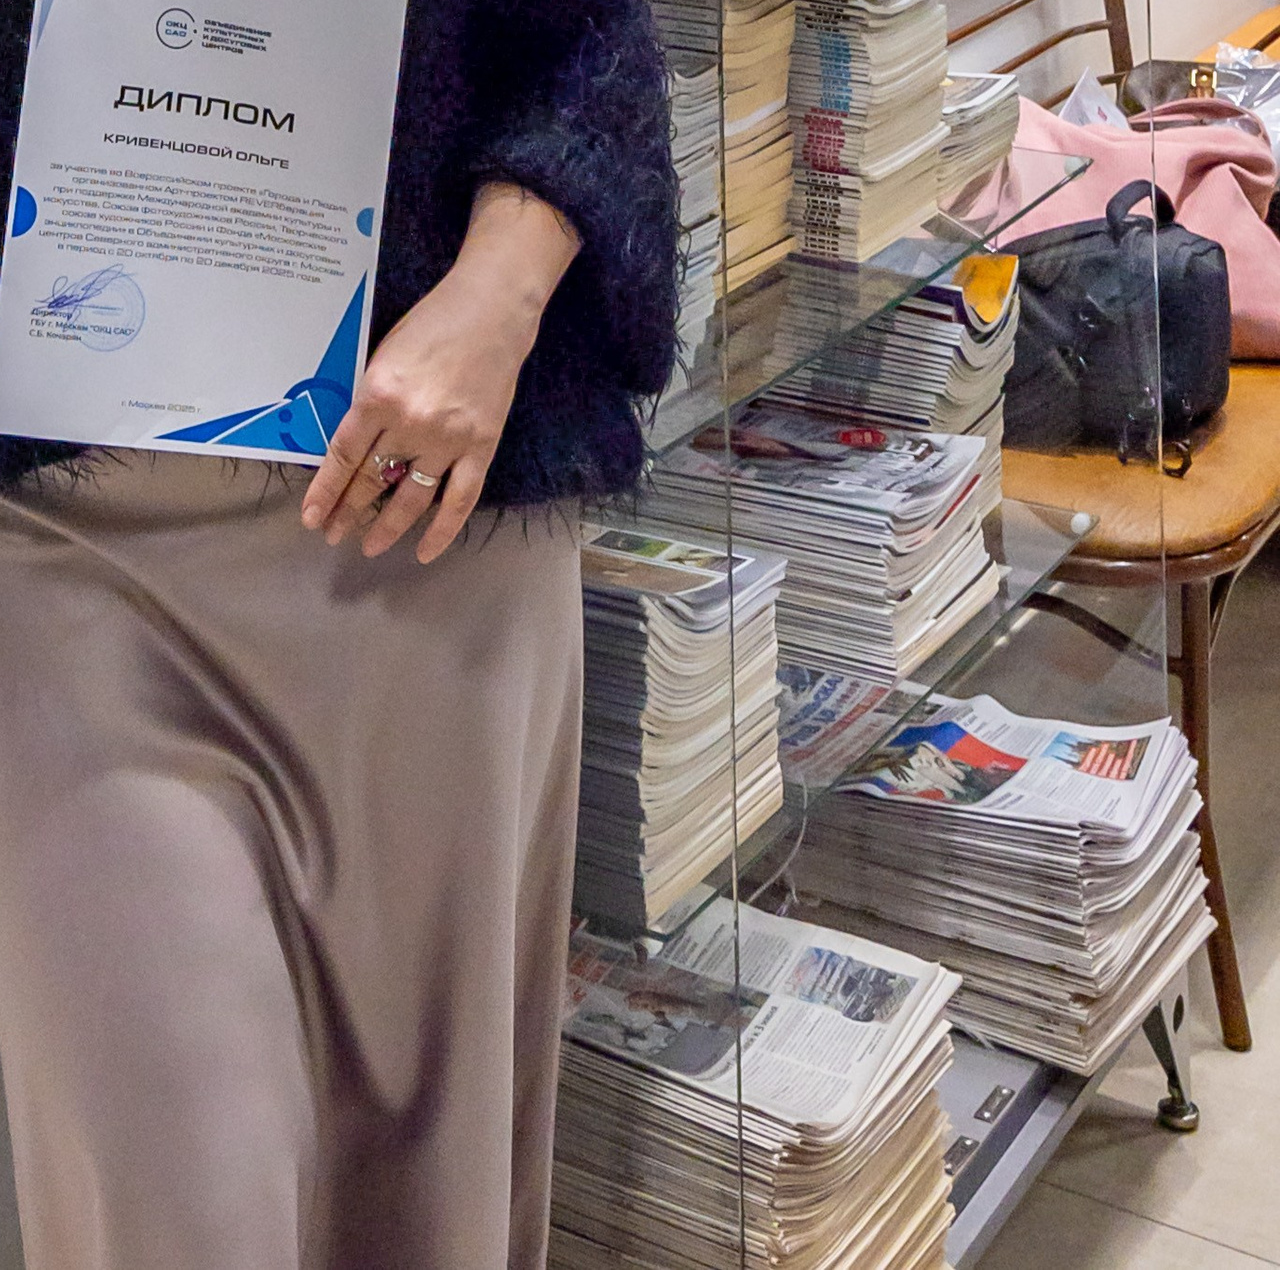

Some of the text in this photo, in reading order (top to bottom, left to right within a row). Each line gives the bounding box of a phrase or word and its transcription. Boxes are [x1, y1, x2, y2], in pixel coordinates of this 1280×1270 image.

[165, 20, 188, 30] ОКЦ
[165, 28, 187, 38] САО
[203, 27, 265, 43] КУЛЬТУРНЫХ
[204, 19, 272, 38] ОБЪЕДИНЕНИЕ
[202, 41, 244, 55] ЦЕНТРОВ
[210, 35, 267, 52] ДОСУГОВЫХ
[113, 85, 295, 133] ДИПЛОМ
[103, 133, 290, 170] КРИВЕНЦОВОЙ ОЛЬГЕ
[64, 164, 108, 175] участие
[124, 169, 211, 188] Всероссийском
[213, 182, 257, 195] проекте
[72, 176, 163, 193] организованном
[52, 185, 73, 195] при
[75, 188, 136, 201] поддержке
[137, 193, 229, 213] Международной
[230, 207, 282, 221] академии
[283, 216, 333, 232] культуры
[61, 210, 97, 220] союза
[98, 213, 163, 227] художников
[164, 219, 206, 233] России
[215, 226, 253, 239] Фонда
[102, 201, 140, 212] Союза
[141, 205, 233, 225] фотохудожников
[281, 225, 349, 246] Творческого
[38, 229, 83, 241] центров
[85, 233, 144, 248] Северного
[146, 240, 253, 262] административного
[254, 254, 290, 268] округа
[300, 260, 345, 277] Москвы
[66, 243, 106, 256] период
[116, 247, 133, 258] 20
[134, 251, 179, 263] октября
[196, 256, 212, 267] 20
[213, 260, 260, 274] декабря
[136, 227, 213, 244] Объединении
[214, 238, 275, 254] культурных
[285, 248, 342, 266] досуговых
[128, 399, 166, 410] Москва
